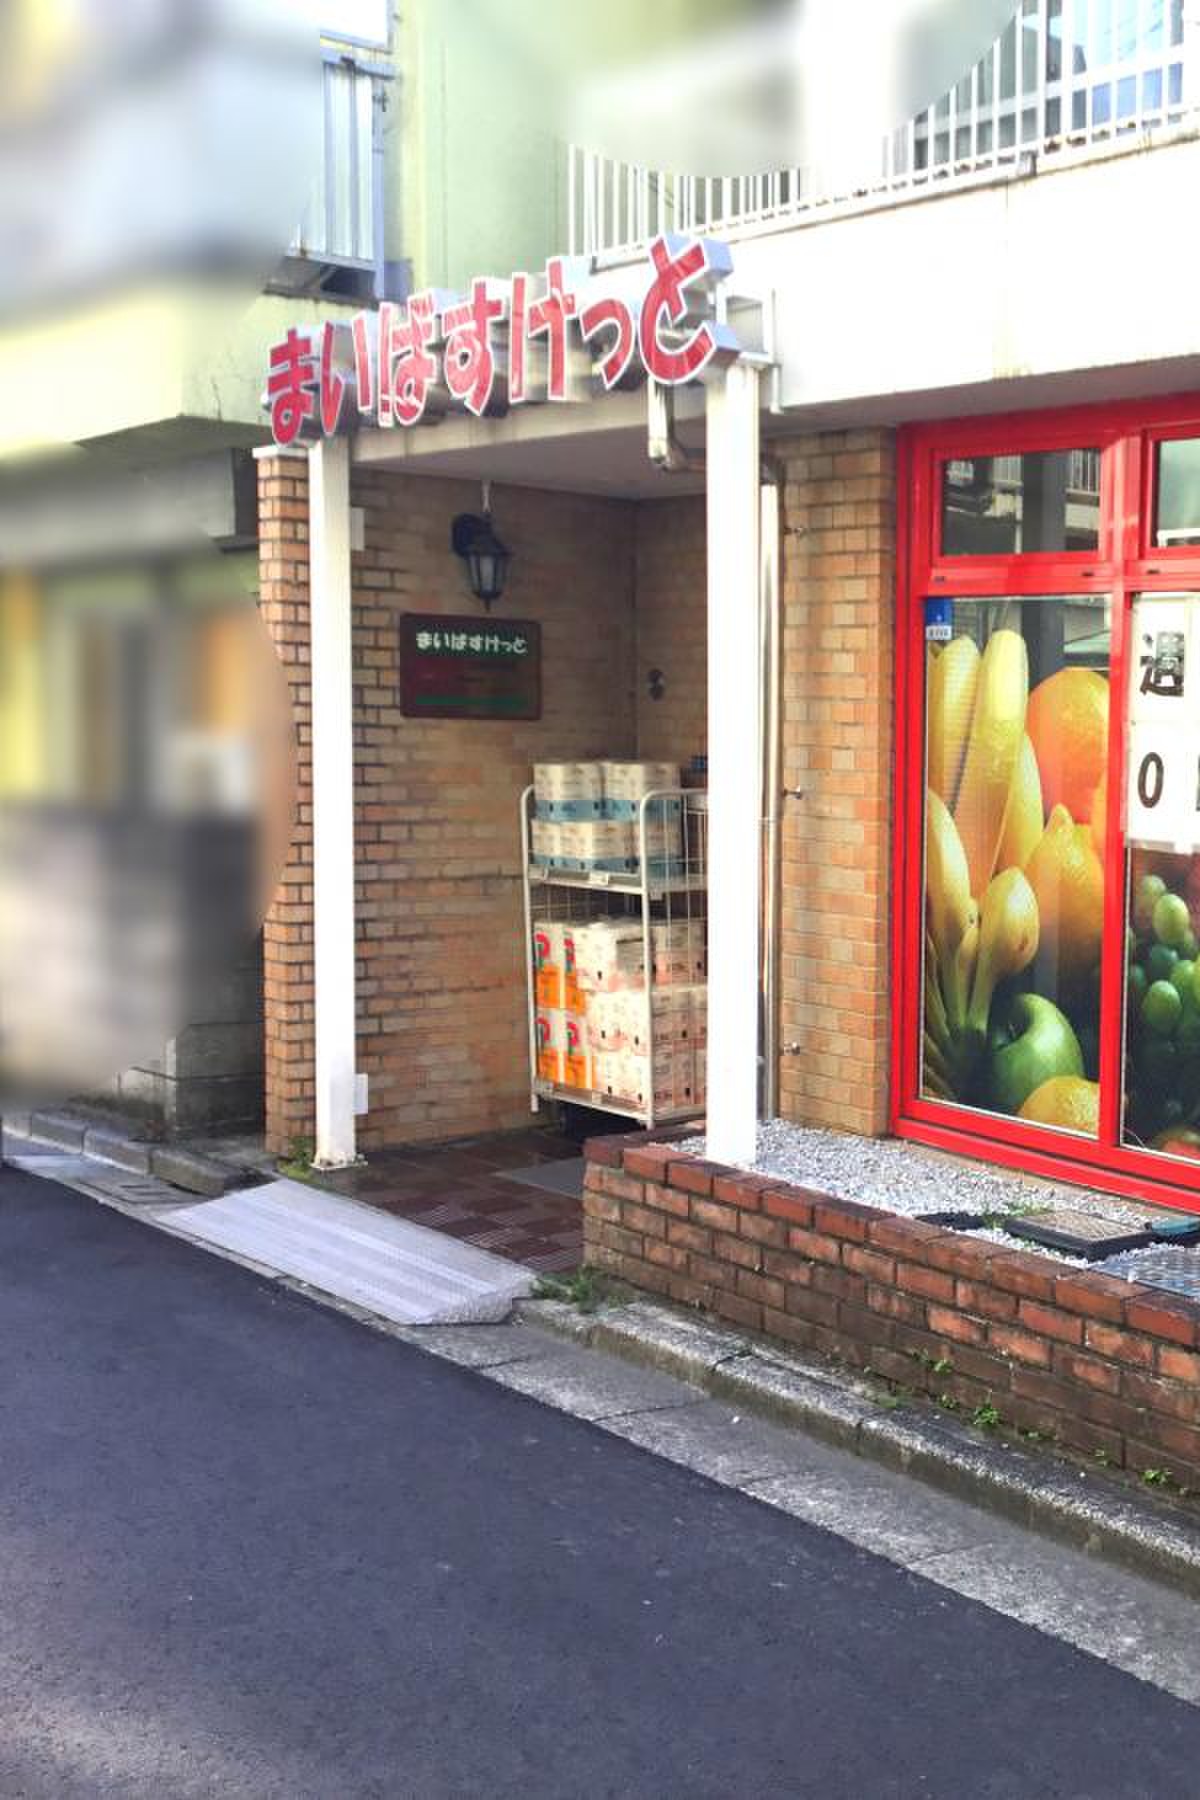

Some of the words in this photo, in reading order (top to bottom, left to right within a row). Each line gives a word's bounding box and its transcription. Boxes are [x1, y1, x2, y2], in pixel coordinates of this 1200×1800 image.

[267, 236, 716, 446] まいばすけっと
[416, 631, 528, 654] まいばすけっと
